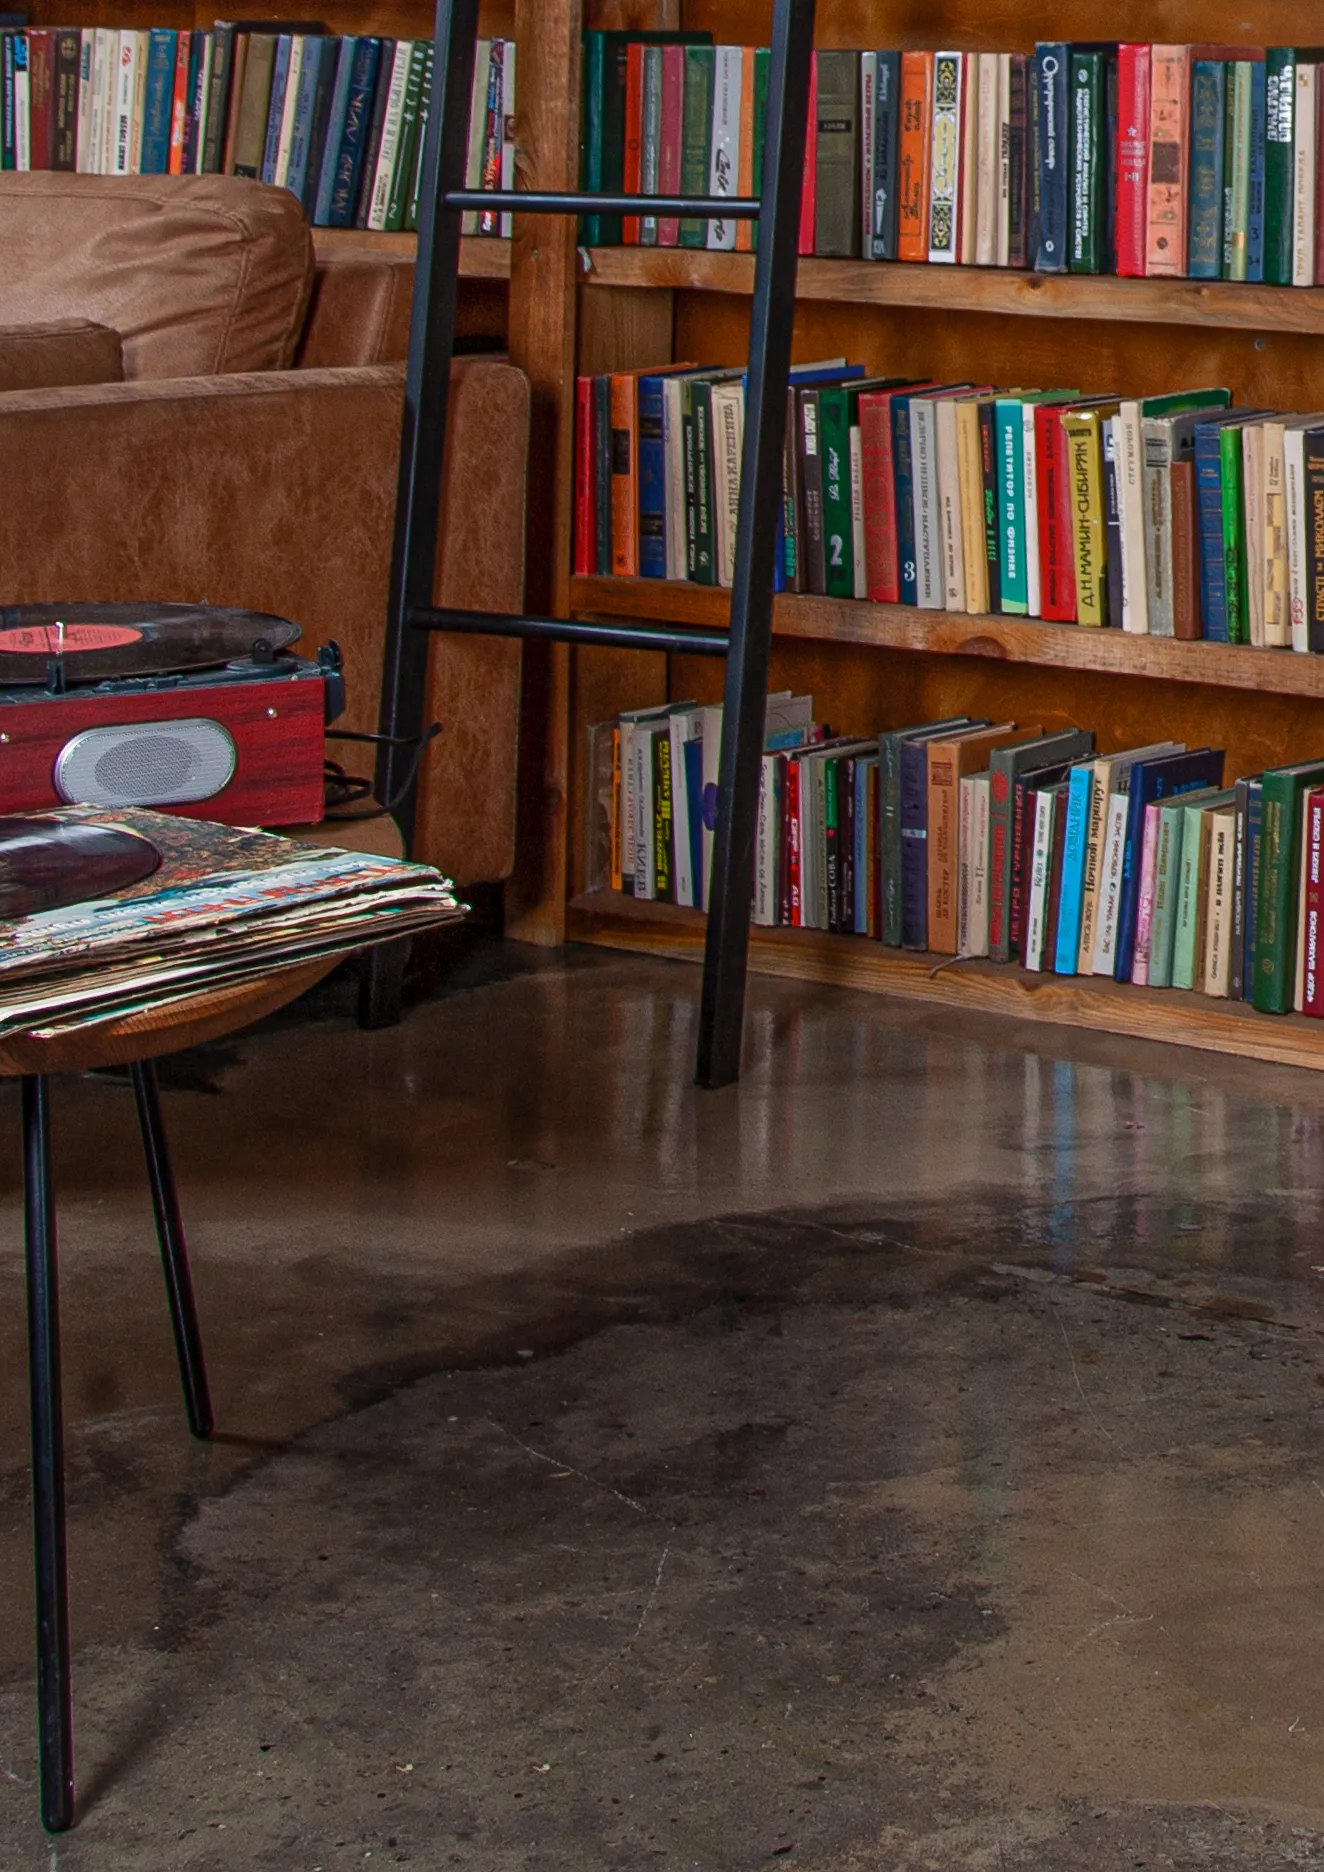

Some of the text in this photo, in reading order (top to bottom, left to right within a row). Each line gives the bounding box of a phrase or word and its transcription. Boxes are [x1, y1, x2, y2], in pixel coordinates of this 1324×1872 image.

[1005, 426, 1016, 579] РЕПЕТИТОР ПО ФИЗИКЕ
[1084, 843, 1098, 892] Ночной
[1091, 778, 1104, 838] маршрут
